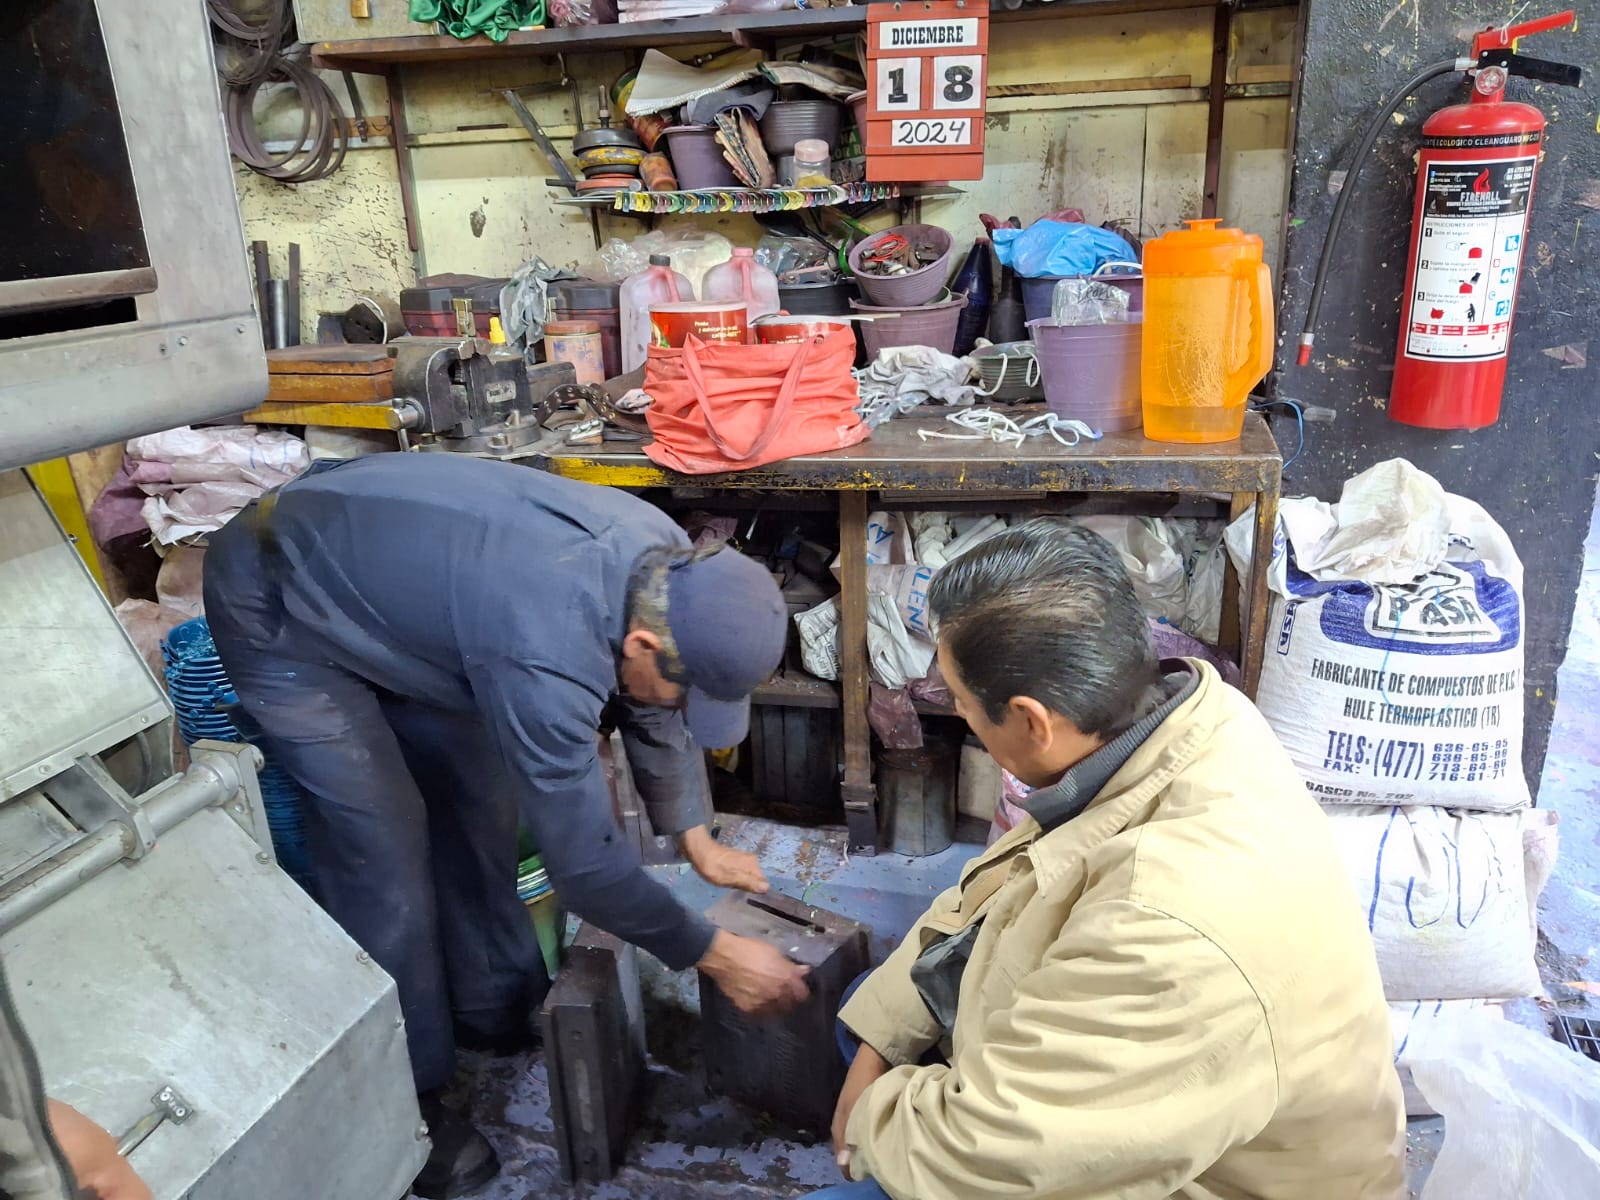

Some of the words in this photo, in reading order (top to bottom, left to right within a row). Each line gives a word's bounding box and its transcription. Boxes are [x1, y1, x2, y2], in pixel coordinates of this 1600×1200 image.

[892, 26, 964, 45] DICIEMBRE
[888, 68, 908, 103] 1
[943, 65, 974, 103] 8
[898, 121, 966, 144] 2024
[1311, 658, 1385, 692] FABRICANTE
[1388, 672, 1405, 694] DE
[1407, 674, 1485, 697] COMPUESTOS
[1486, 673, 1498, 695] DE
[1343, 697, 1376, 721] HULE
[1379, 702, 1478, 728] TERMOPLASTICO
[1481, 704, 1500, 730] (TR)
[1323, 758, 1361, 774] FAX:
[1327, 730, 1373, 765] TELS:
[1373, 738, 1425, 781] (477)
